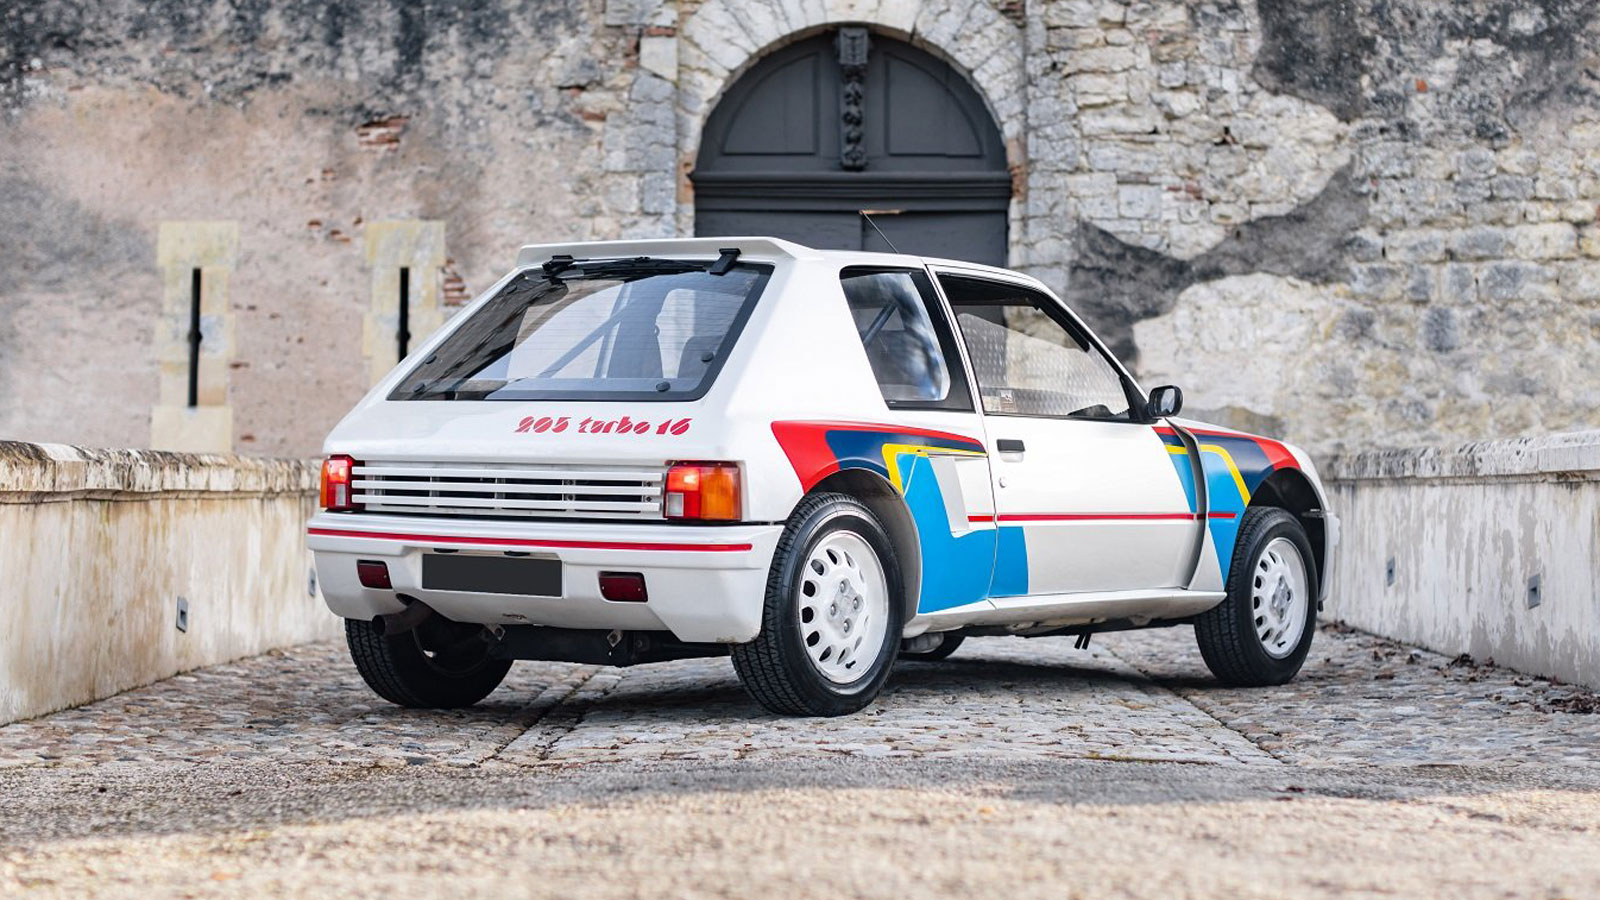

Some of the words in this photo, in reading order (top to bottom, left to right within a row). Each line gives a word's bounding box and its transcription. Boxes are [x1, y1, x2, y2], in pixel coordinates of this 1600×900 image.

[515, 416, 572, 434] 205
[577, 416, 652, 435] turbo
[655, 417, 693, 436] 16
